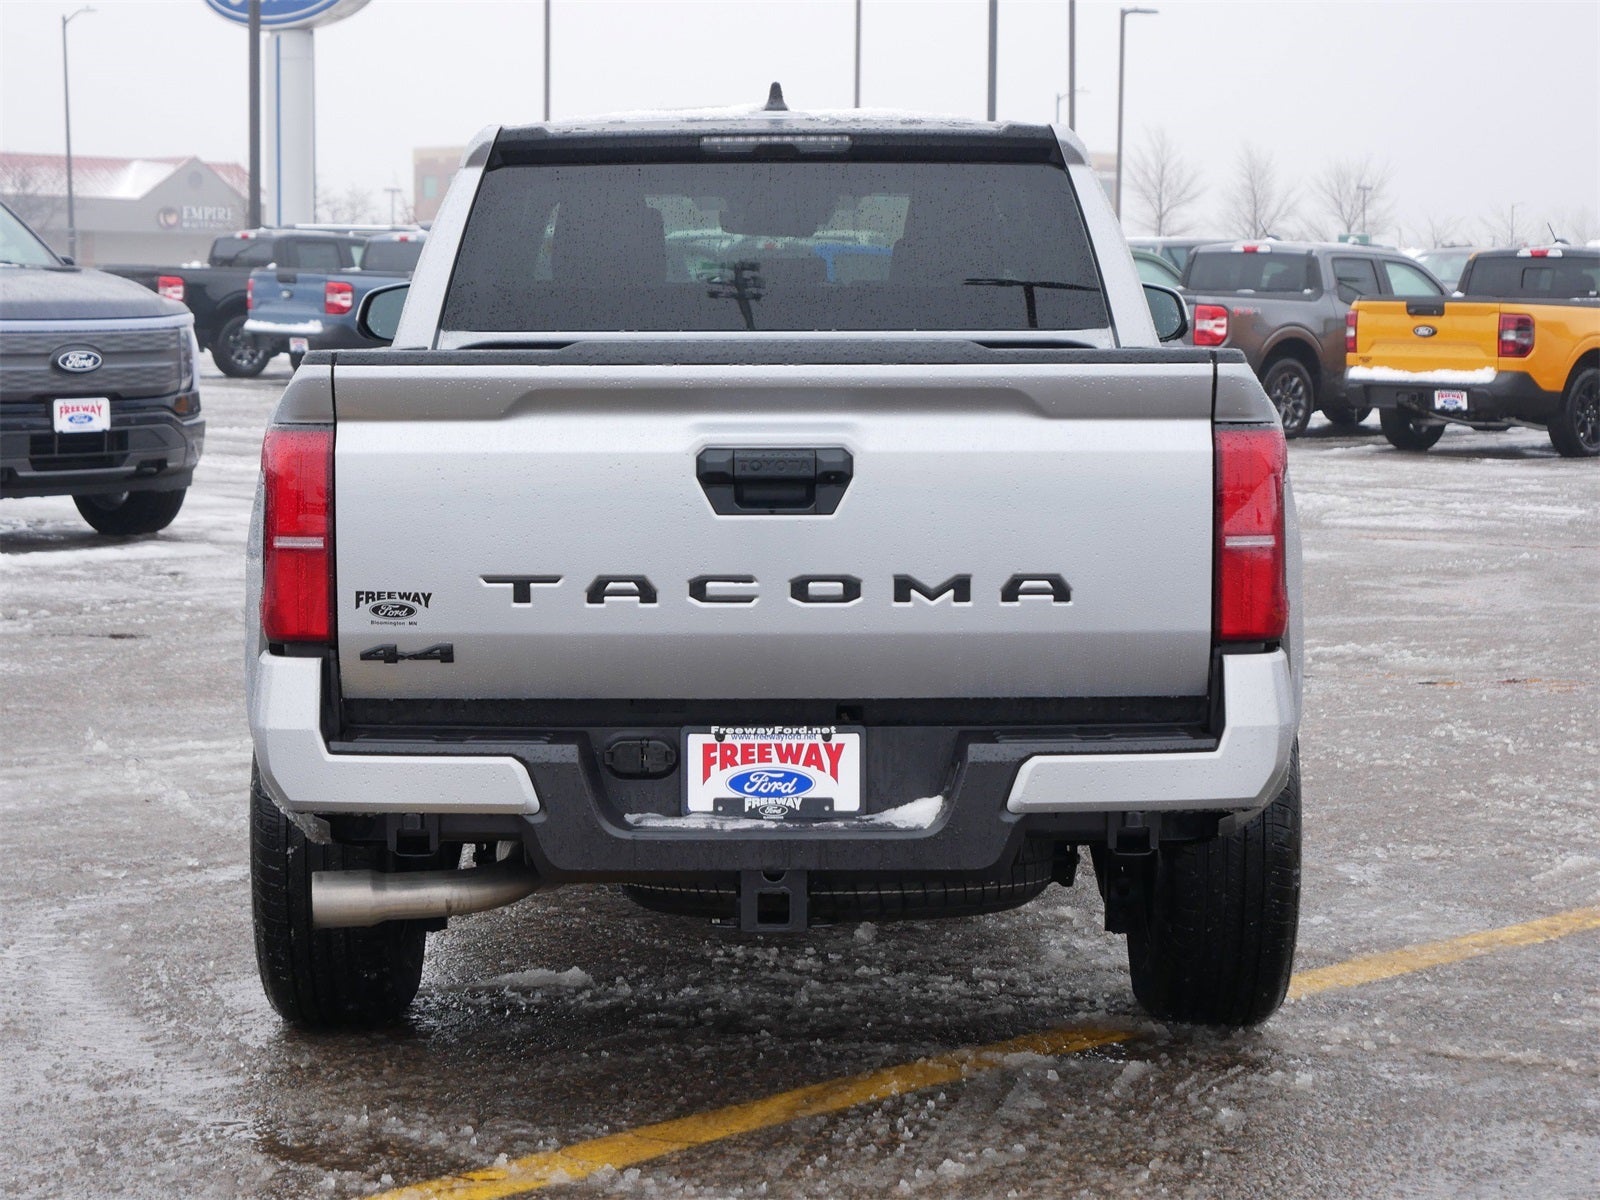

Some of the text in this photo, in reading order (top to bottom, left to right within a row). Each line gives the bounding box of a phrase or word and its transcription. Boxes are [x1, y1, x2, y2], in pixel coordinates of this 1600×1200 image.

[66, 352, 94, 367] Ford
[59, 405, 102, 418] FREEWAY
[739, 459, 812, 472] TOYOTA
[480, 573, 1073, 606] TACOMA
[355, 590, 432, 610] FREEWAY
[378, 604, 408, 617] Ford
[370, 619, 406, 627] Bloomington
[710, 725, 837, 737] FreewayFord.net
[731, 732, 817, 742] www.freewayford.net
[702, 742, 846, 786] FREEWAY
[743, 771, 798, 794] Ford
[744, 797, 803, 812] FREEWAY
[764, 806, 782, 814] Ford
